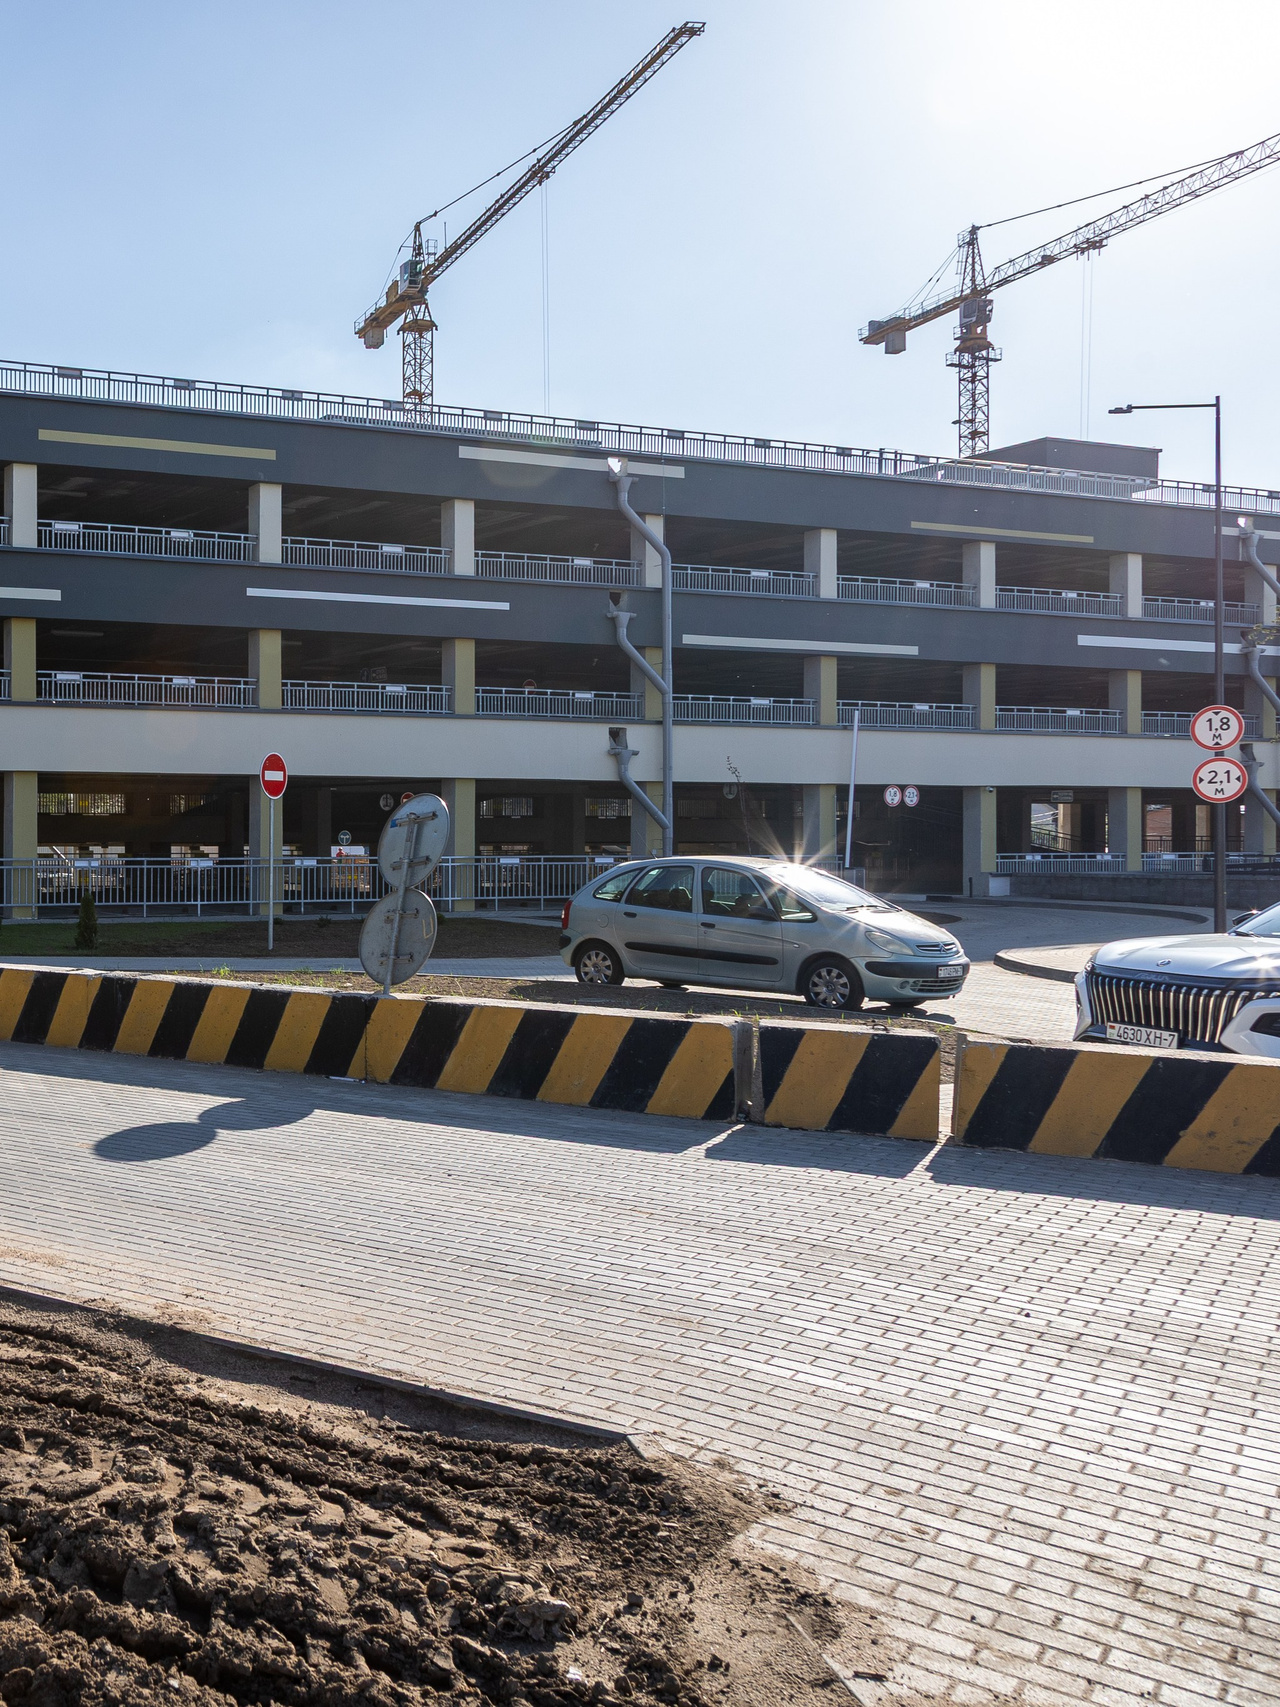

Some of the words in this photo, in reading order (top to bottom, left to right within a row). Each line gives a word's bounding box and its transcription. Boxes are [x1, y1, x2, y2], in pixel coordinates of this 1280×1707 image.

[1206, 716, 1231, 733] 1,8
[1207, 769, 1231, 786] 2,1
[1116, 1025, 1143, 1042] 4630
[1144, 1029, 1176, 1047] XH-7
